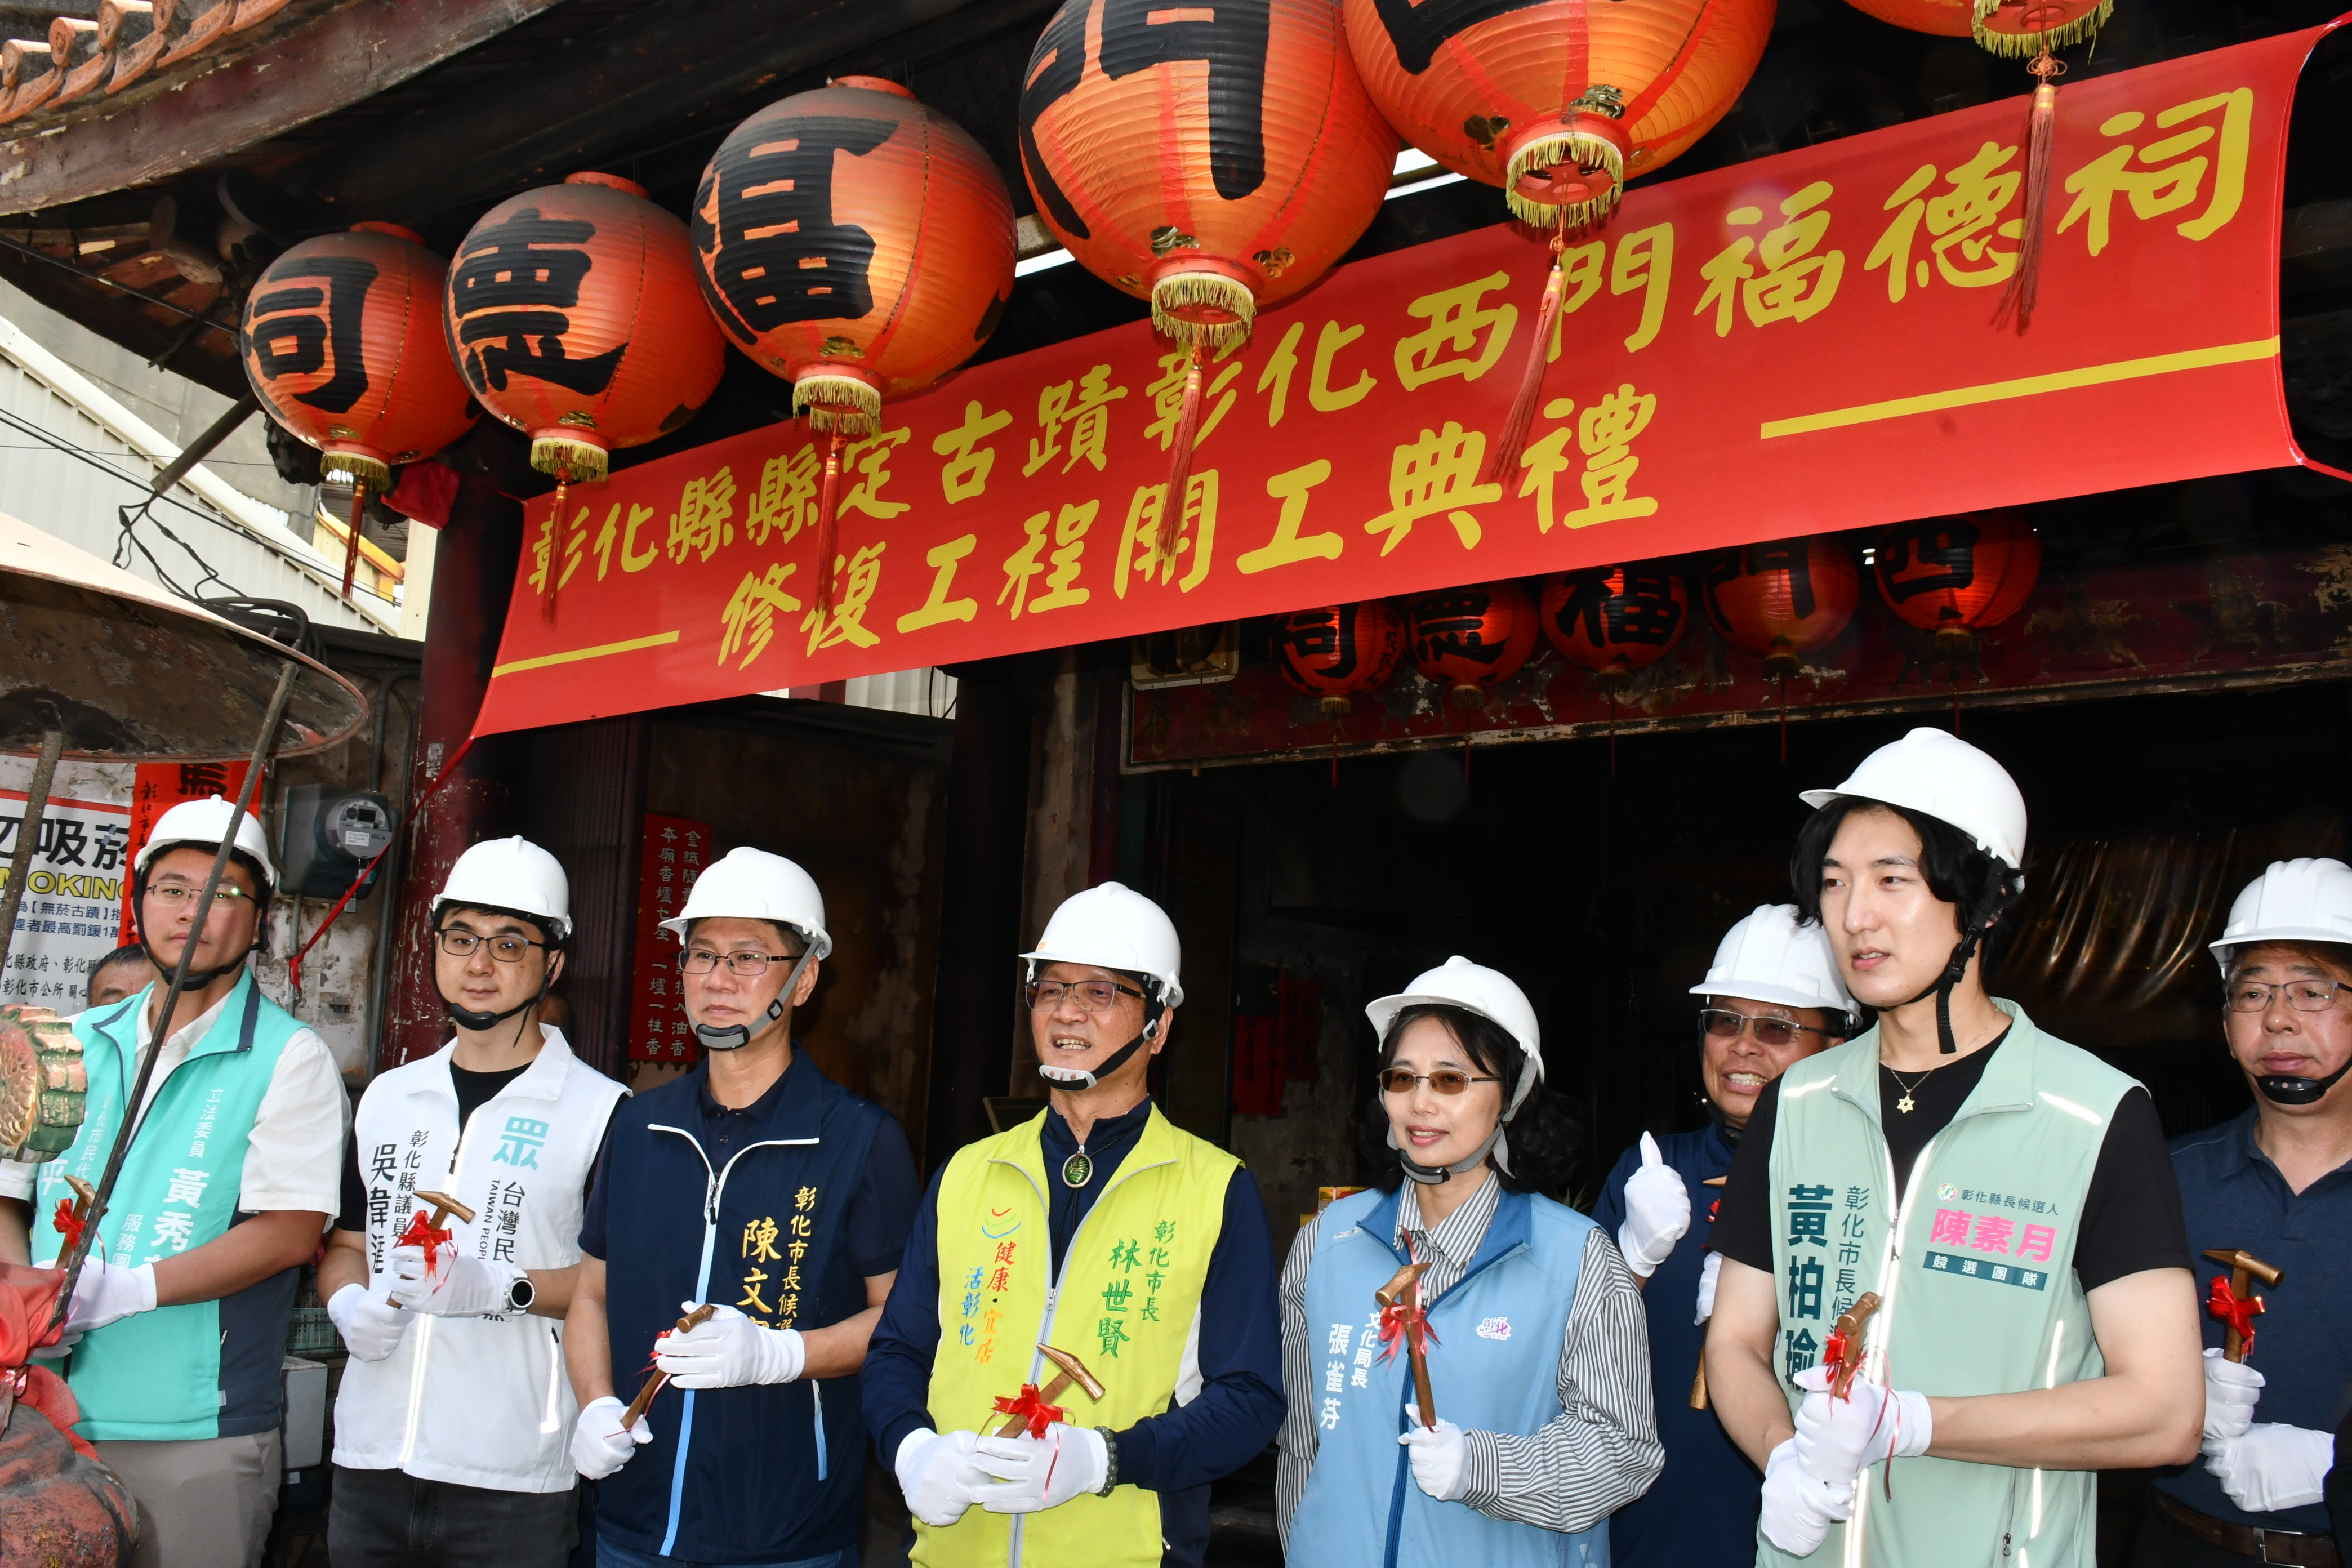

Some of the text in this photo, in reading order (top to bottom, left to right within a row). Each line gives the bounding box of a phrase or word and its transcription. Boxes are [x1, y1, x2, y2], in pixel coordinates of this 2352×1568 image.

[529, 87, 2253, 595] 彰化縣縣定古蹟彰化西門福德祠
[718, 383, 1657, 670] 修復工程開工典禮
[0, 867, 124, 900] OKIN
[391, 1130, 429, 1237] 彰化縣議員
[492, 1116, 550, 1170] 眾
[144, 1168, 210, 1263] 黃秀
[484, 1179, 500, 1223] TAIWAN
[1930, 1208, 2057, 1263] 陳素月
[1961, 1189, 2059, 1216] 彰化縣長候選人
[736, 1217, 782, 1328] 陳文
[960, 1266, 984, 1346] 活彰化
[1098, 1239, 1143, 1358] 林世賢
[1140, 1220, 1177, 1322] 彰化市長
[1785, 1184, 1834, 1392] 黃柏瑜
[1830, 1186, 1870, 1336] 彰化市長候
[1932, 1254, 2038, 1286] 競選團隊
[1320, 1324, 1353, 1430] 張雀芬
[1351, 1312, 1382, 1389] 文化局長
